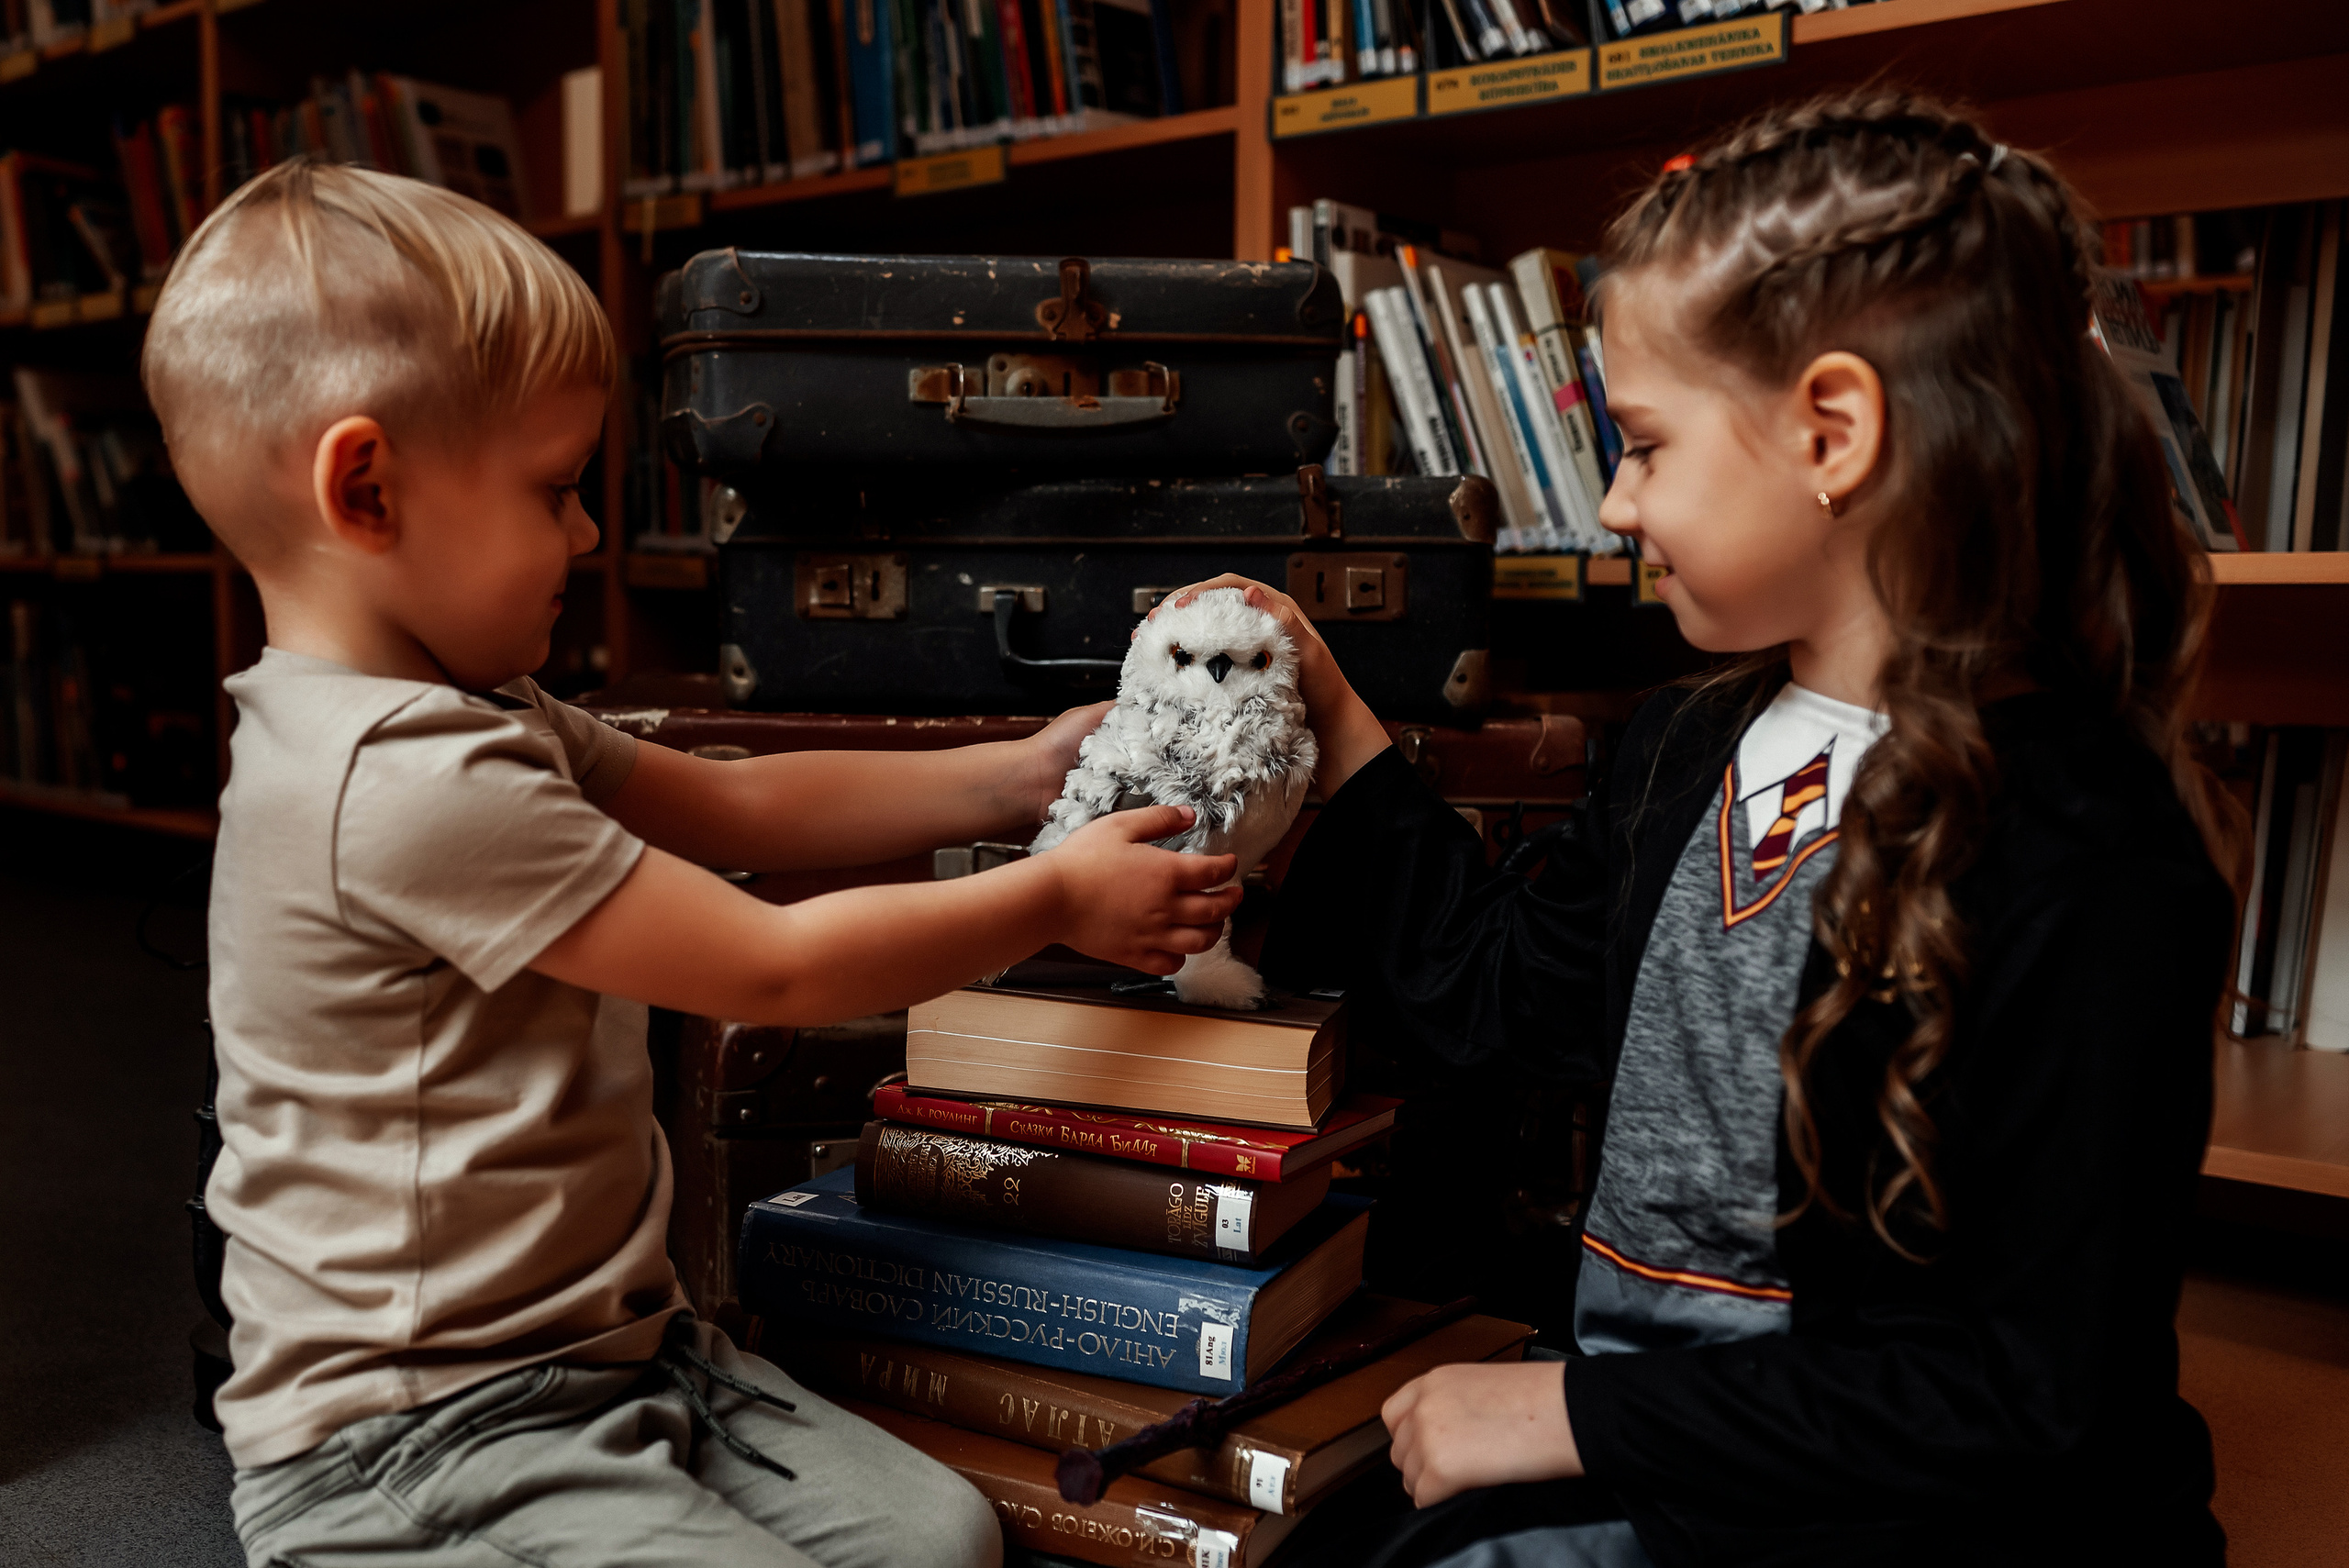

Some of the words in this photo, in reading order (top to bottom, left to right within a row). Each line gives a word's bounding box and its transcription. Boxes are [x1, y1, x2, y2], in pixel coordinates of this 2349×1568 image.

[929, 1108, 977, 1125] РОУЛИНГ
[1003, 1177, 1020, 1206] 22
[1165, 1183, 1185, 1242] TOBĀGO
[1221, 1218, 1230, 1229] 03
[1233, 1218, 1242, 1234] Lat
[763, 1241, 924, 1289] DICTIONARY
[801, 1280, 924, 1321] СЛОВАРЬ
[931, 1271, 1181, 1338] ENGLISH-RUSSIAN
[931, 1303, 1177, 1369] АНГЛО-РУССКИЙ
[1205, 1335, 1216, 1366] 81Ang
[858, 1351, 949, 1407] МИРА
[998, 1392, 1116, 1449] АТЛАС
[987, 1498, 1043, 1529] СЛО
